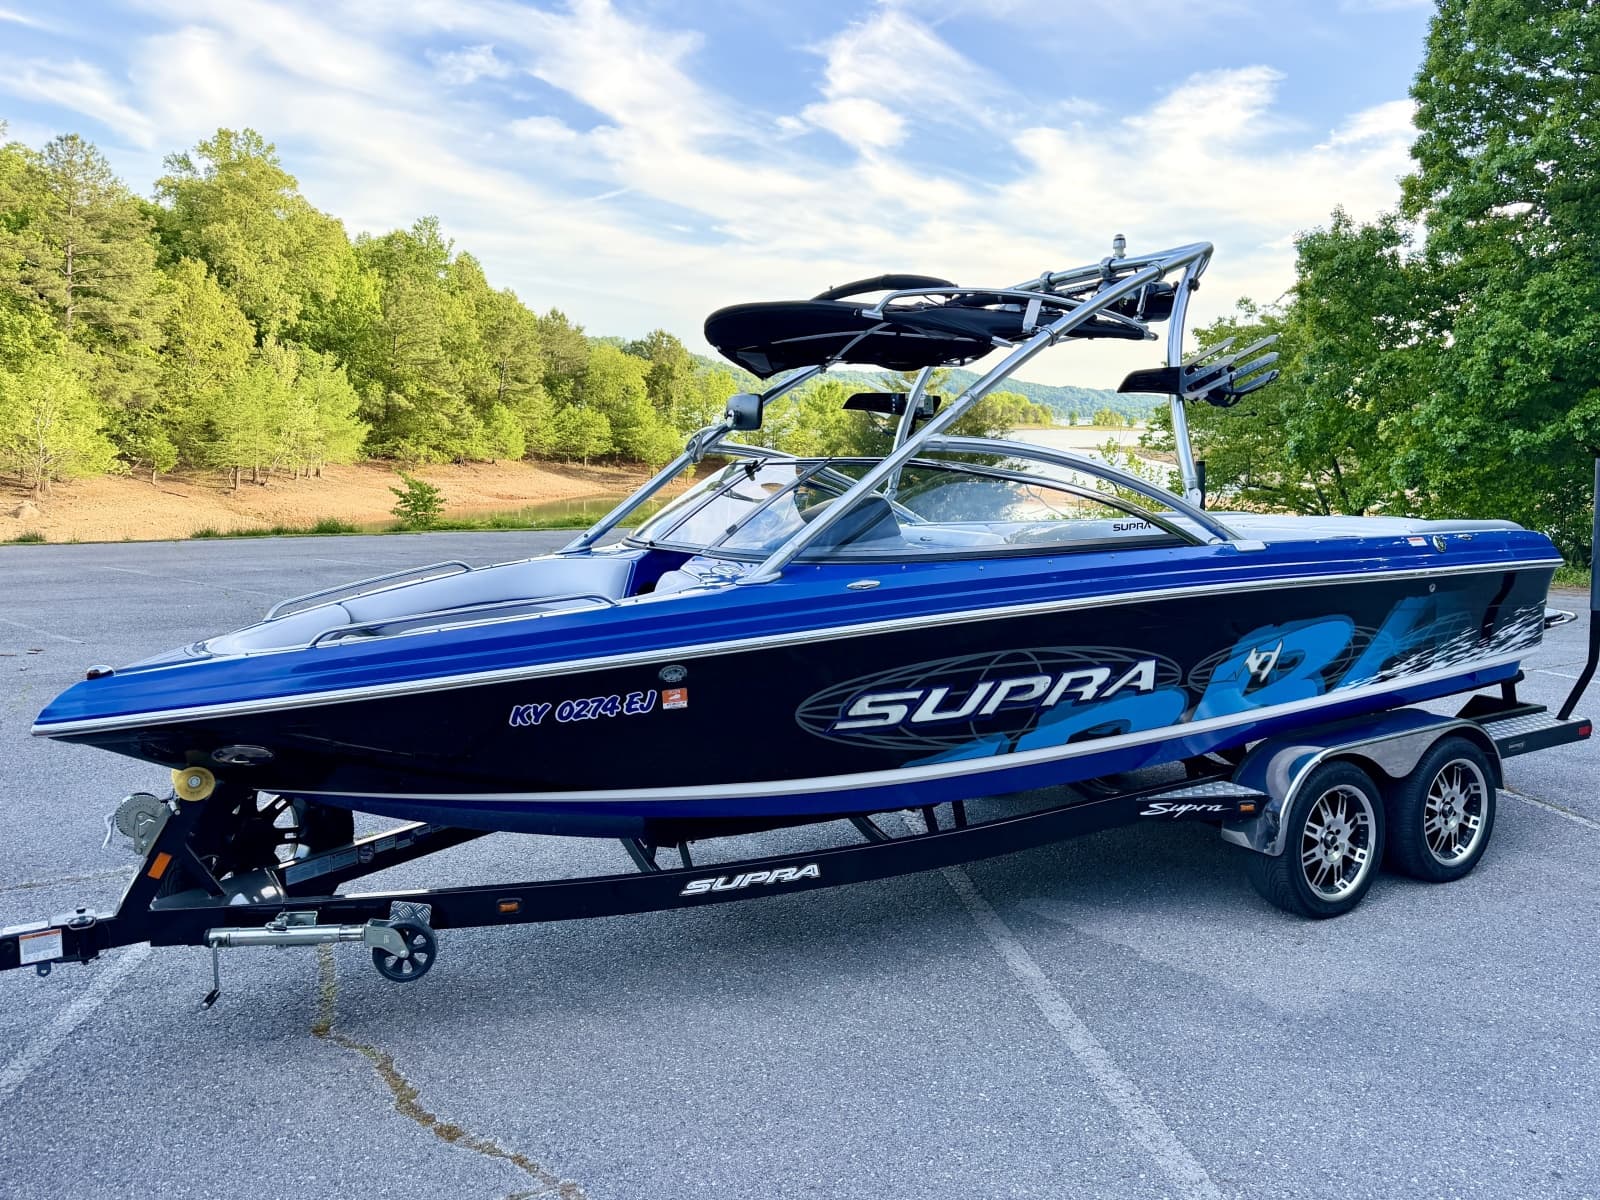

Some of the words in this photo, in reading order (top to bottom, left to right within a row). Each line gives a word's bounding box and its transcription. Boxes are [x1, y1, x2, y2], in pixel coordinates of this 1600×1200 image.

[1112, 521, 1151, 532] SUPRA
[509, 703, 551, 727] KY
[555, 695, 621, 723] 0274
[623, 689, 657, 715] EJ
[832, 659, 1157, 730] SUPRA
[1139, 802, 1233, 818] Supra
[679, 863, 820, 896] SUPRA
